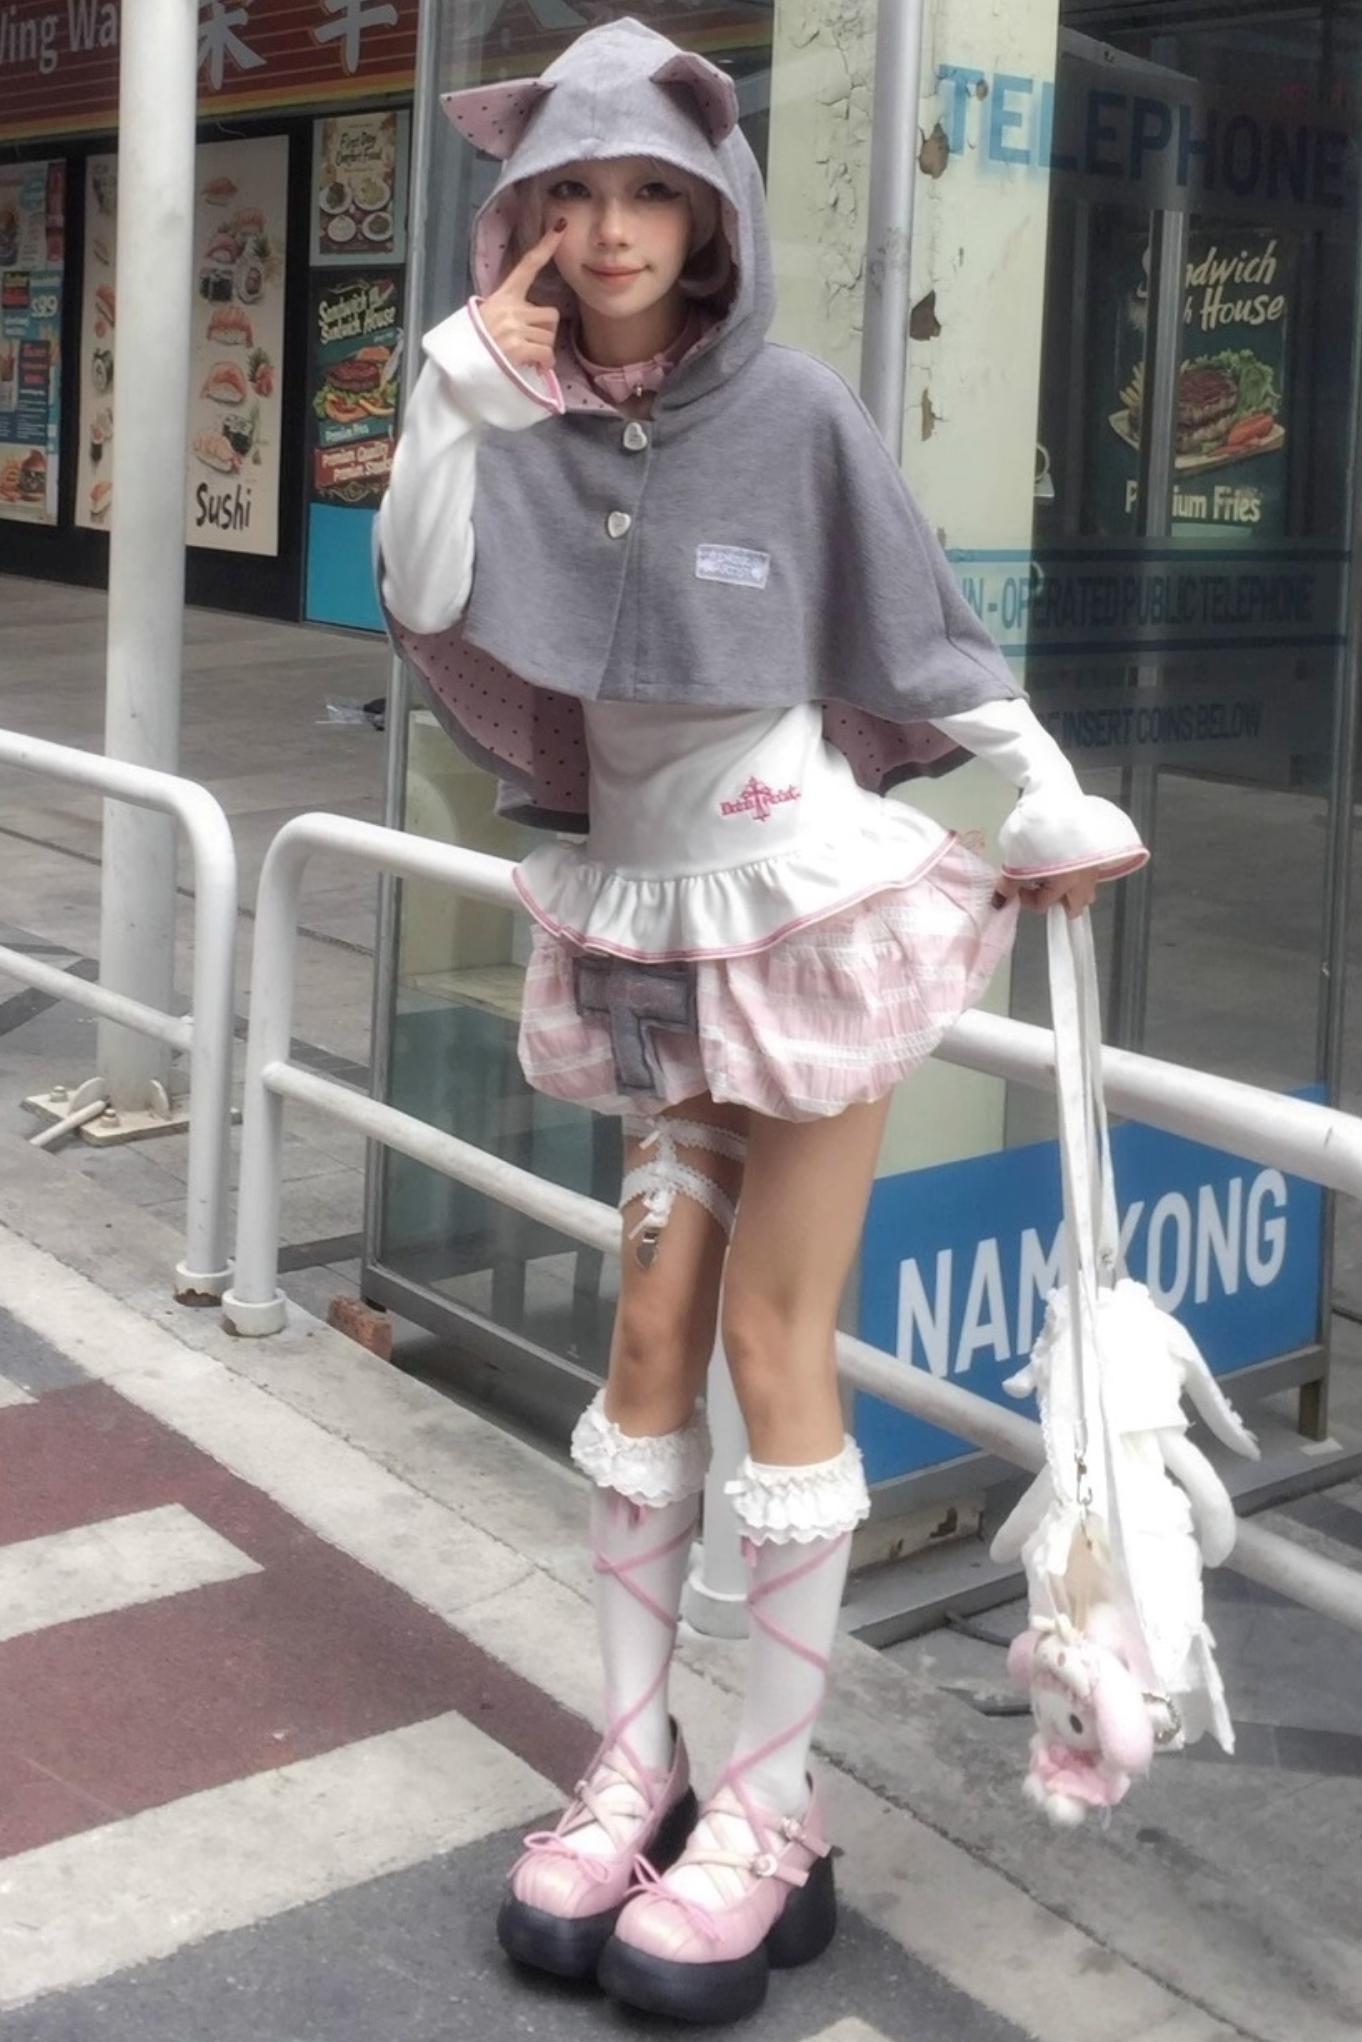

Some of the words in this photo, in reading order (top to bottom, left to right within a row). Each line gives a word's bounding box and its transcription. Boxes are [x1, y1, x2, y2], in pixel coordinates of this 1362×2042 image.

[0, 4, 58, 75] ing
[938, 64, 1348, 207] TELEPHONE
[1200, 286, 1283, 331] House
[195, 482, 252, 531] Sushi
[1125, 479, 1207, 519] Pium
[1211, 485, 1260, 522] Fries
[1197, 574, 1315, 624] TELEPHONE
[1062, 707, 1134, 747] INSERT
[1136, 704, 1192, 745] COINS
[1196, 701, 1263, 741] BELOW
